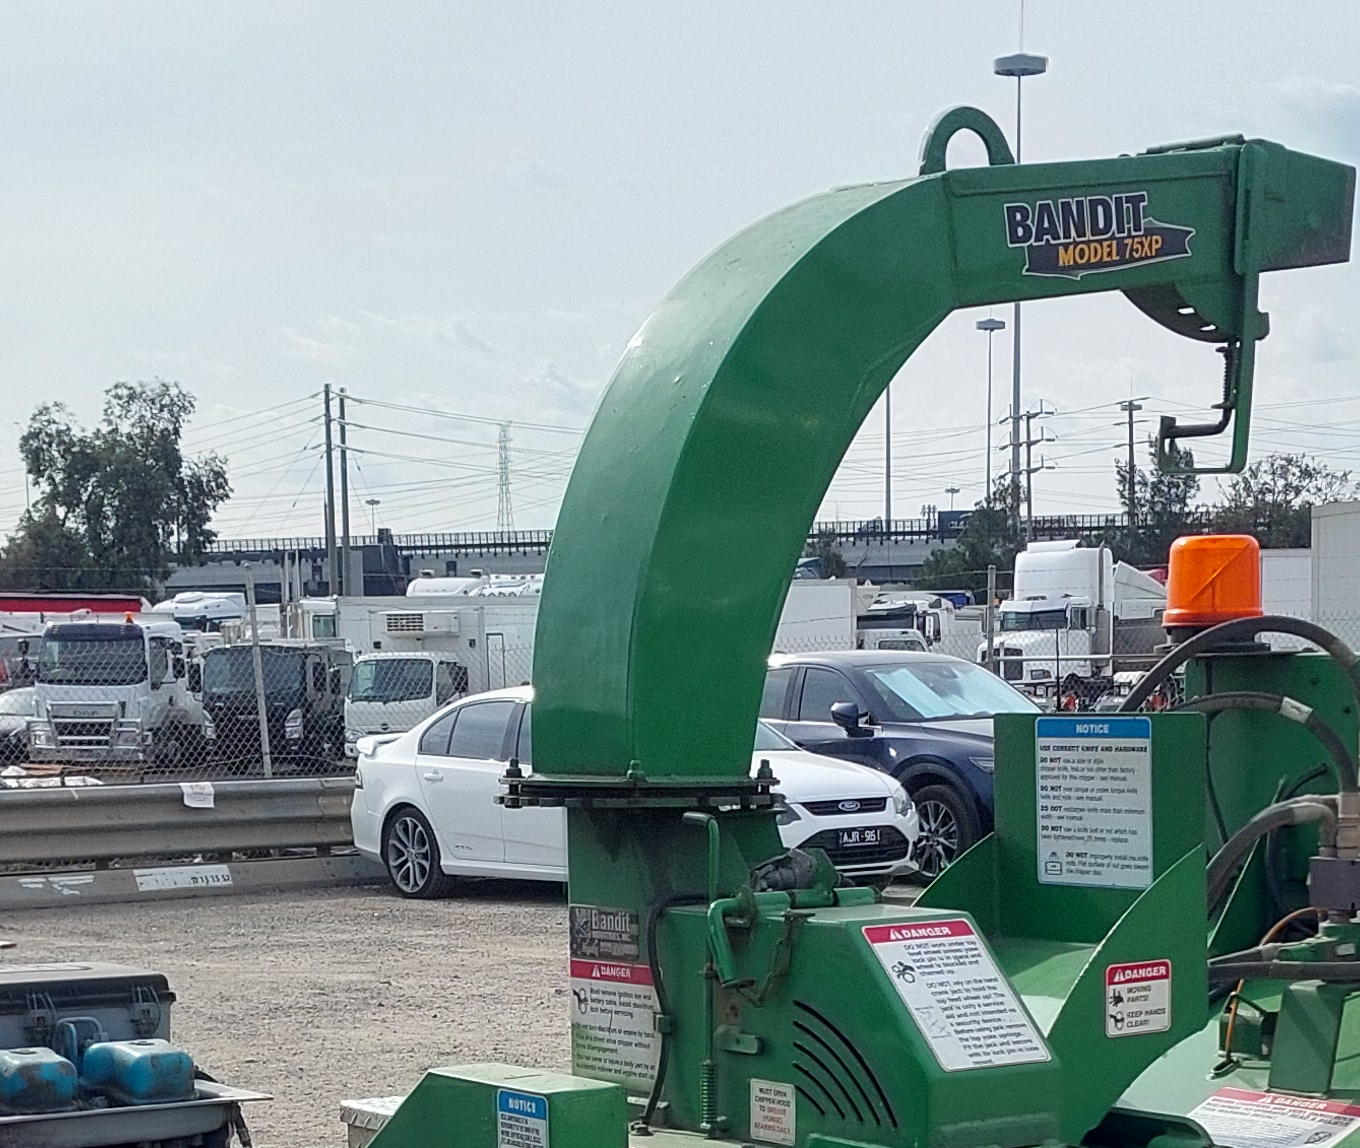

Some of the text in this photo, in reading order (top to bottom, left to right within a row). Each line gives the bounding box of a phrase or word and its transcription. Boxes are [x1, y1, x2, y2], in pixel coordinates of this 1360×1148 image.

[1004, 191, 1147, 248] BANDIT
[1058, 235, 1163, 267] MODEL 75XP
[1075, 723, 1110, 734] NOTICE
[591, 908, 630, 932] Bandit
[901, 926, 951, 939] DANGER
[601, 966, 631, 978] DANGER
[1124, 966, 1167, 980] DANGER
[508, 1097, 536, 1114] NOTICE
[1274, 1097, 1328, 1110] DANGER
